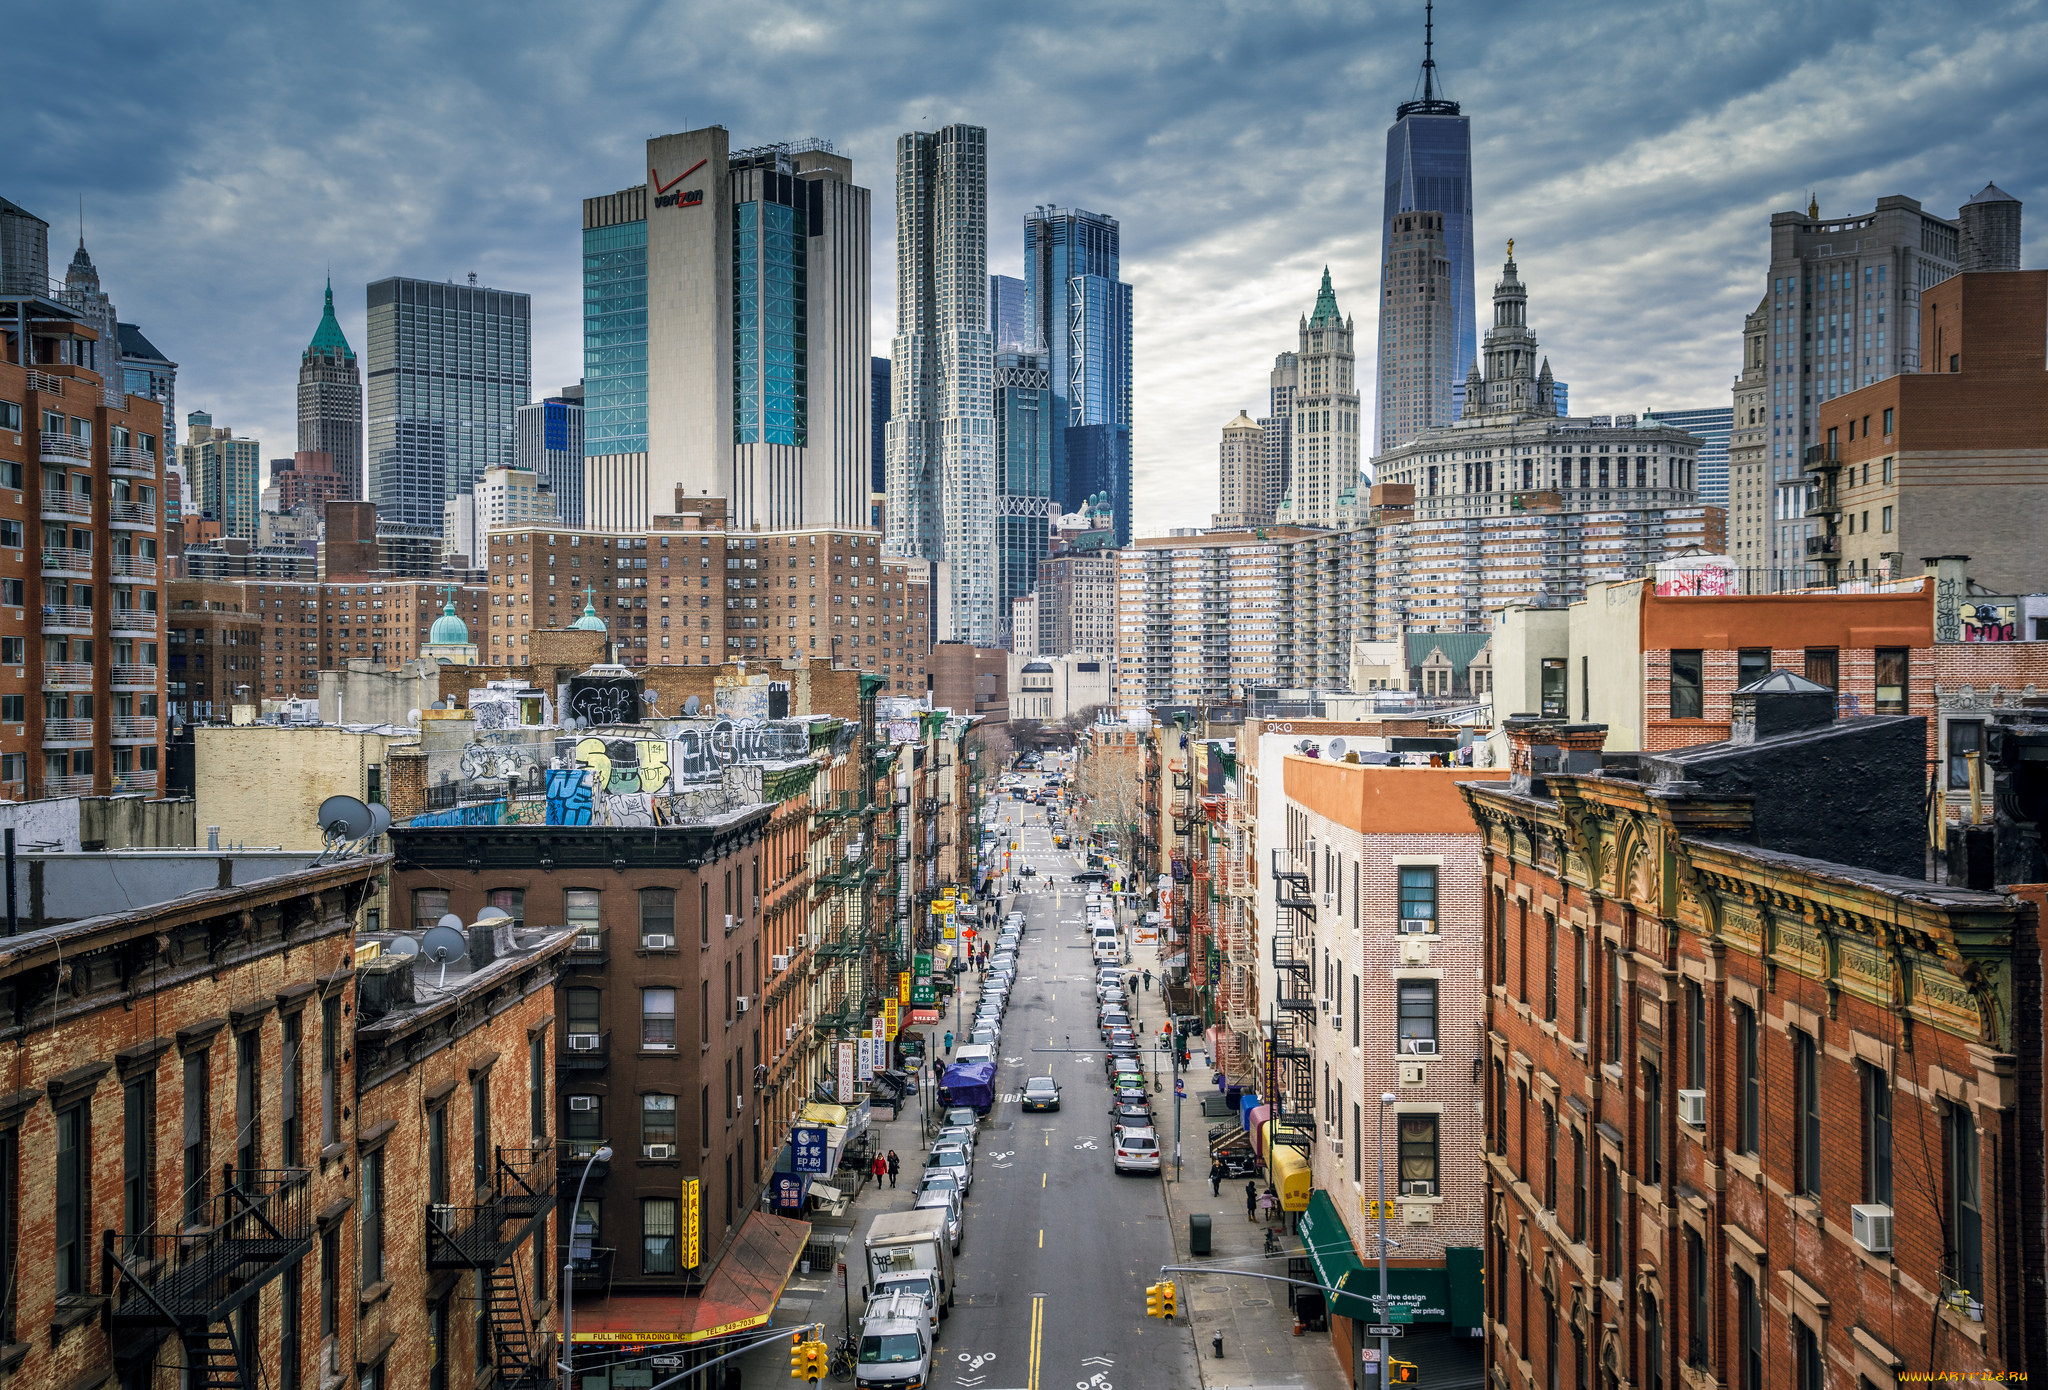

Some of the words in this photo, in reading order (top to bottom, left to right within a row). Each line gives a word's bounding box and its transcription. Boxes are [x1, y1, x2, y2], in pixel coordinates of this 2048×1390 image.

[654, 189, 703, 208] verizon
[1267, 722, 1292, 733] OKO
[797, 1158, 820, 1167] 印刷
[1422, 1308, 1445, 1316] printing
[705, 1327, 720, 1336] TEL:
[724, 1319, 756, 1331] 349-7036
[593, 1333, 612, 1341] FULL
[614, 1333, 633, 1341] HING
[636, 1333, 671, 1341] TRADING
[673, 1333, 688, 1341] INC.
